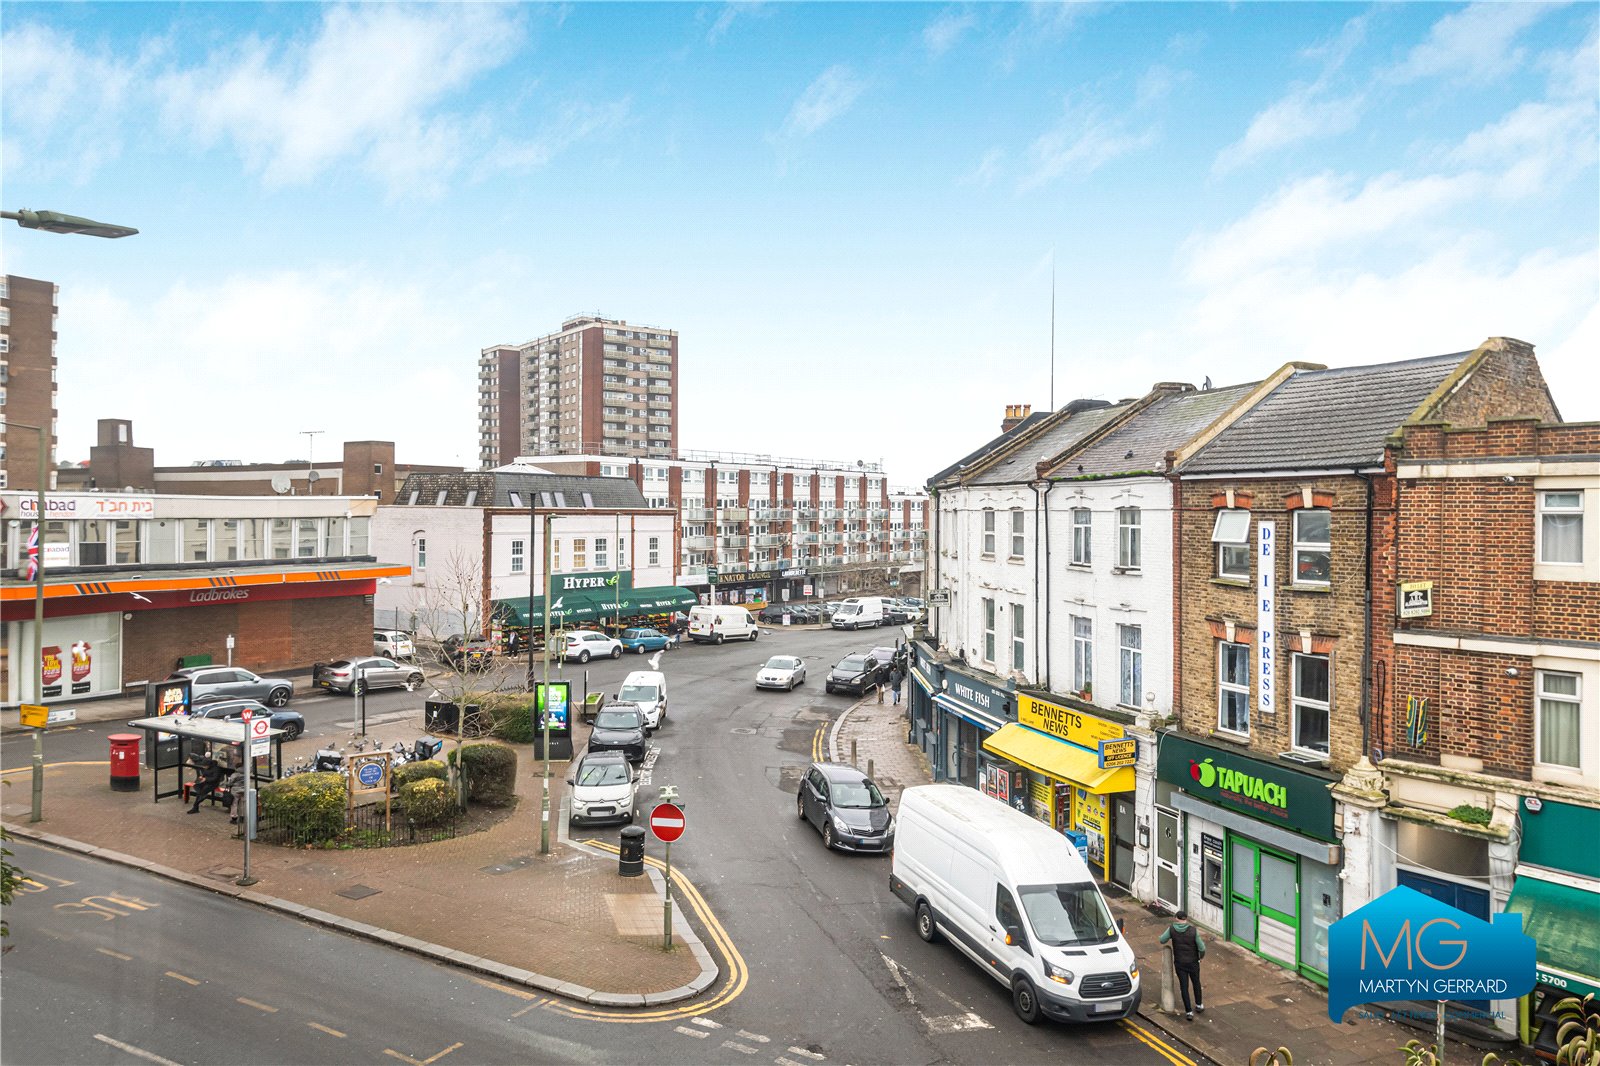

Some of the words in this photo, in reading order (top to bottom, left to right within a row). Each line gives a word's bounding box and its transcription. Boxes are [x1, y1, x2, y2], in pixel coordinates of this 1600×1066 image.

[20, 499, 76, 511] chbad
[131, 500, 153, 512] בית
[563, 576, 606, 590] HYPER
[719, 573, 746, 583] ENATOR
[748, 571, 771, 580] LOUNGE
[190, 588, 250, 602] Ladbrokes
[1262, 630, 1271, 706] PRESS
[955, 682, 974, 701] WHITE
[975, 690, 990, 708] FISH
[1031, 701, 1082, 729] BENNETTS
[1043, 718, 1069, 737] NEWS
[1105, 741, 1134, 751] BENNETTS
[1217, 766, 1287, 809] TAPUACH
[1165, 827, 1171, 838] 6
[1541, 974, 1567, 988] 5700
